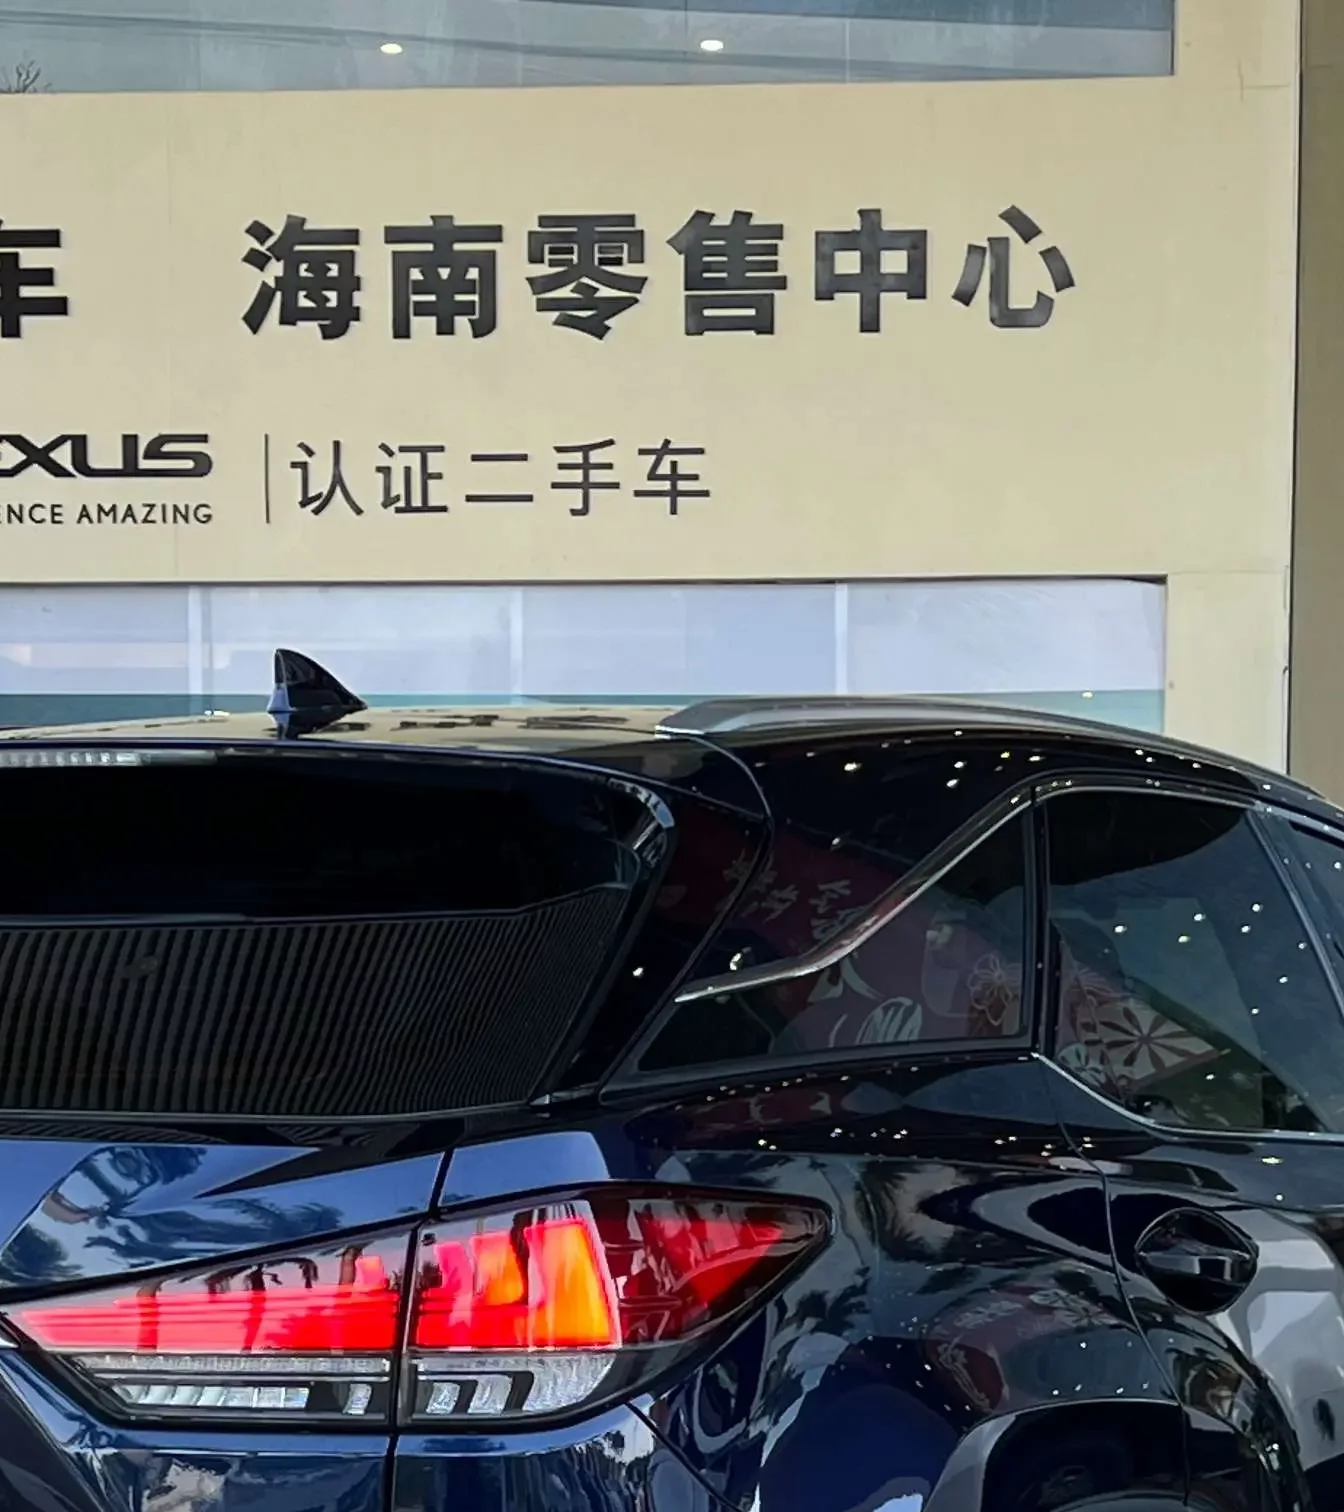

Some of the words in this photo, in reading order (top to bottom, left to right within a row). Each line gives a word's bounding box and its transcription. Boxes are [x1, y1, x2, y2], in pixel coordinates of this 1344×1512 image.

[242, 205, 1076, 341] 海南零售中心
[76, 503, 214, 526] AMAZING
[295, 437, 712, 517] 认证二手车
